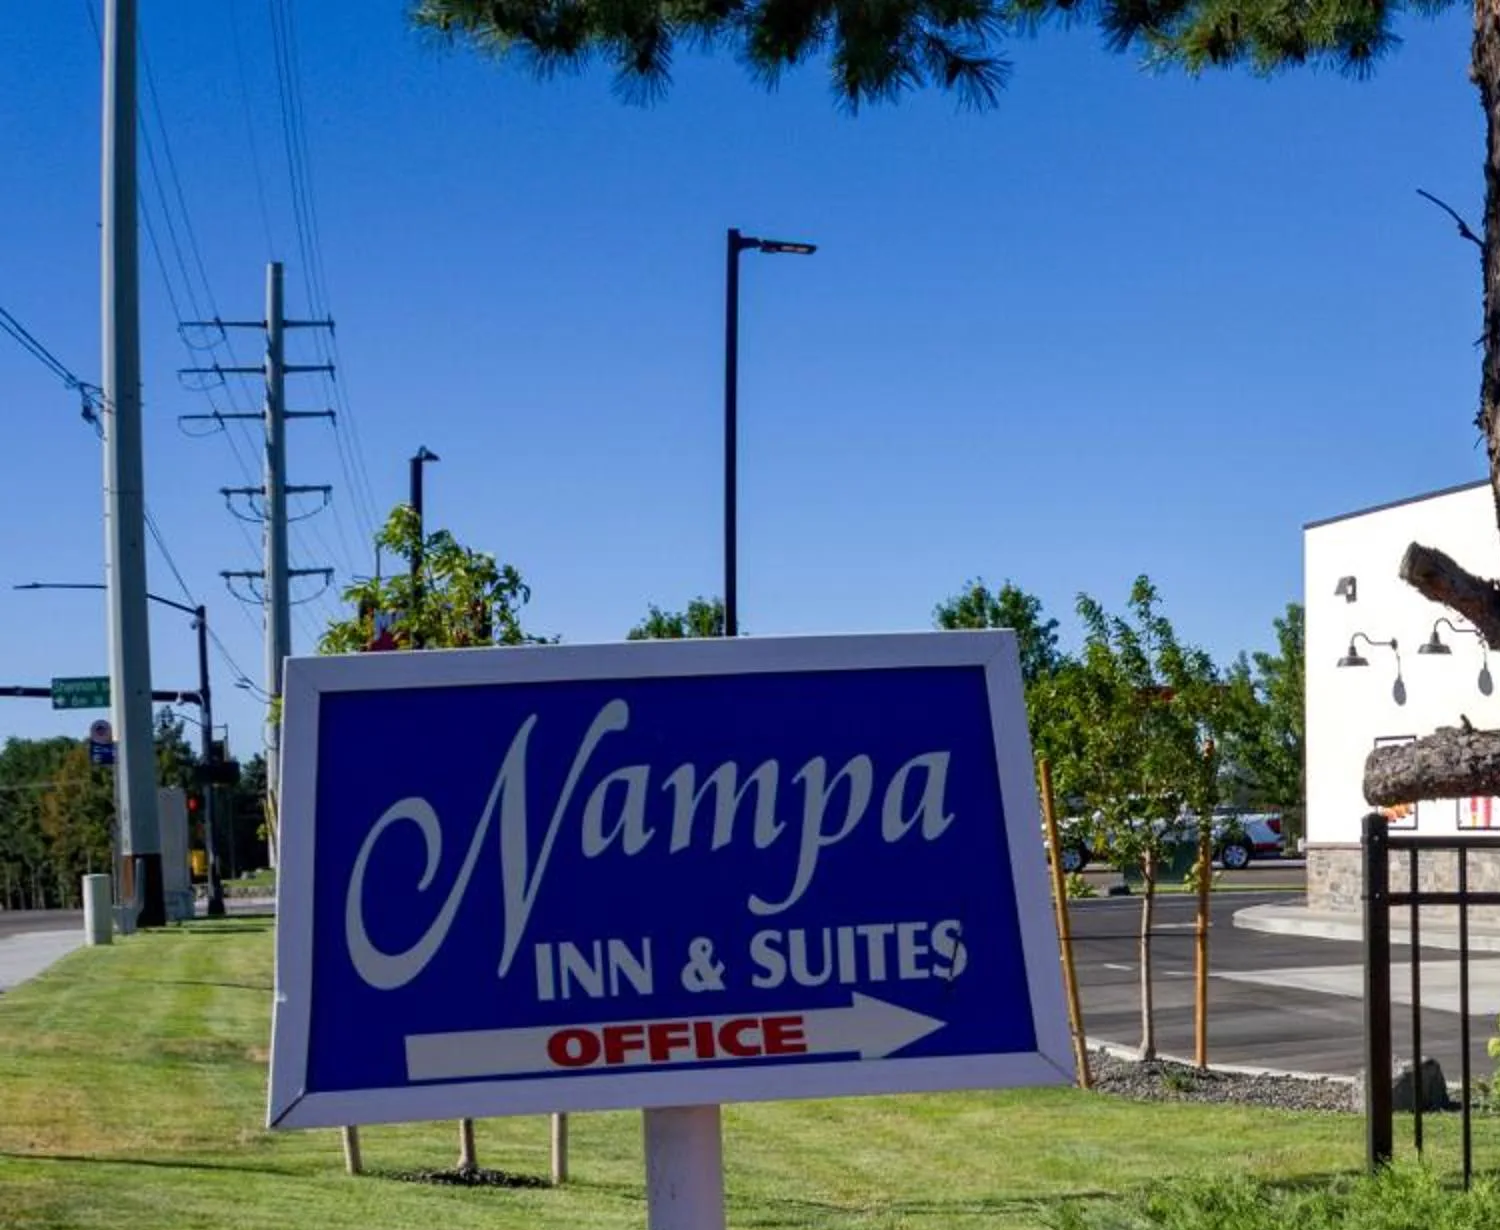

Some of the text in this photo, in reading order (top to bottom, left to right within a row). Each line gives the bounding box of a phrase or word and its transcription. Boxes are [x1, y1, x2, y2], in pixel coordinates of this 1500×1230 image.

[345, 698, 955, 991] Nampa
[534, 919, 969, 1001] INN & SUITES
[546, 1015, 808, 1069] OFFICE
